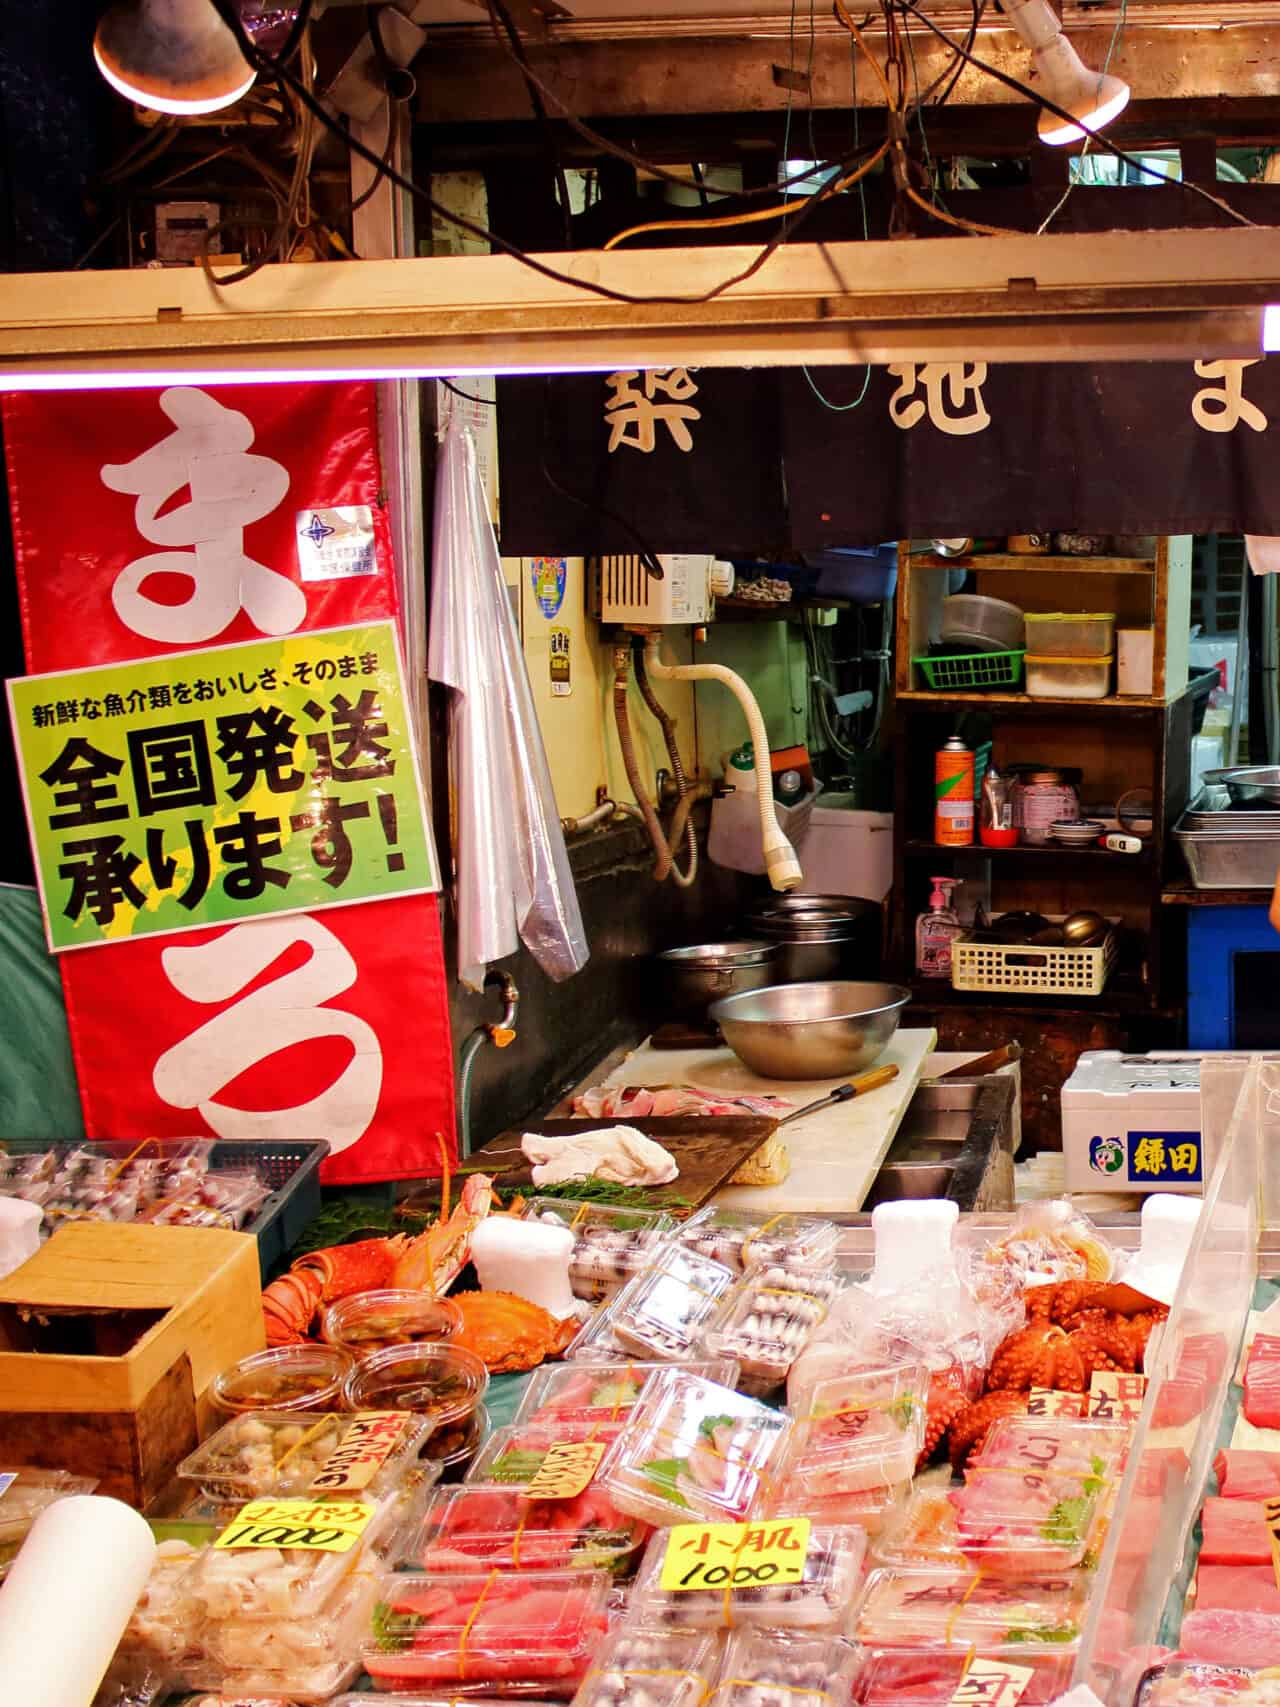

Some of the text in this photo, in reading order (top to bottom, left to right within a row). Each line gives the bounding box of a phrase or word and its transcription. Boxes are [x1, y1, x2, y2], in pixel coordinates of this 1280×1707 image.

[31, 652, 379, 728] 新鮮な魚介類をおいしさ、そのまま
[38, 690, 397, 830] 全国発送
[58, 793, 405, 926] 承ります!
[1133, 1136, 1198, 1175] 鎌田
[224, 1525, 345, 1545] 1000
[679, 1526, 801, 1555] 小肌
